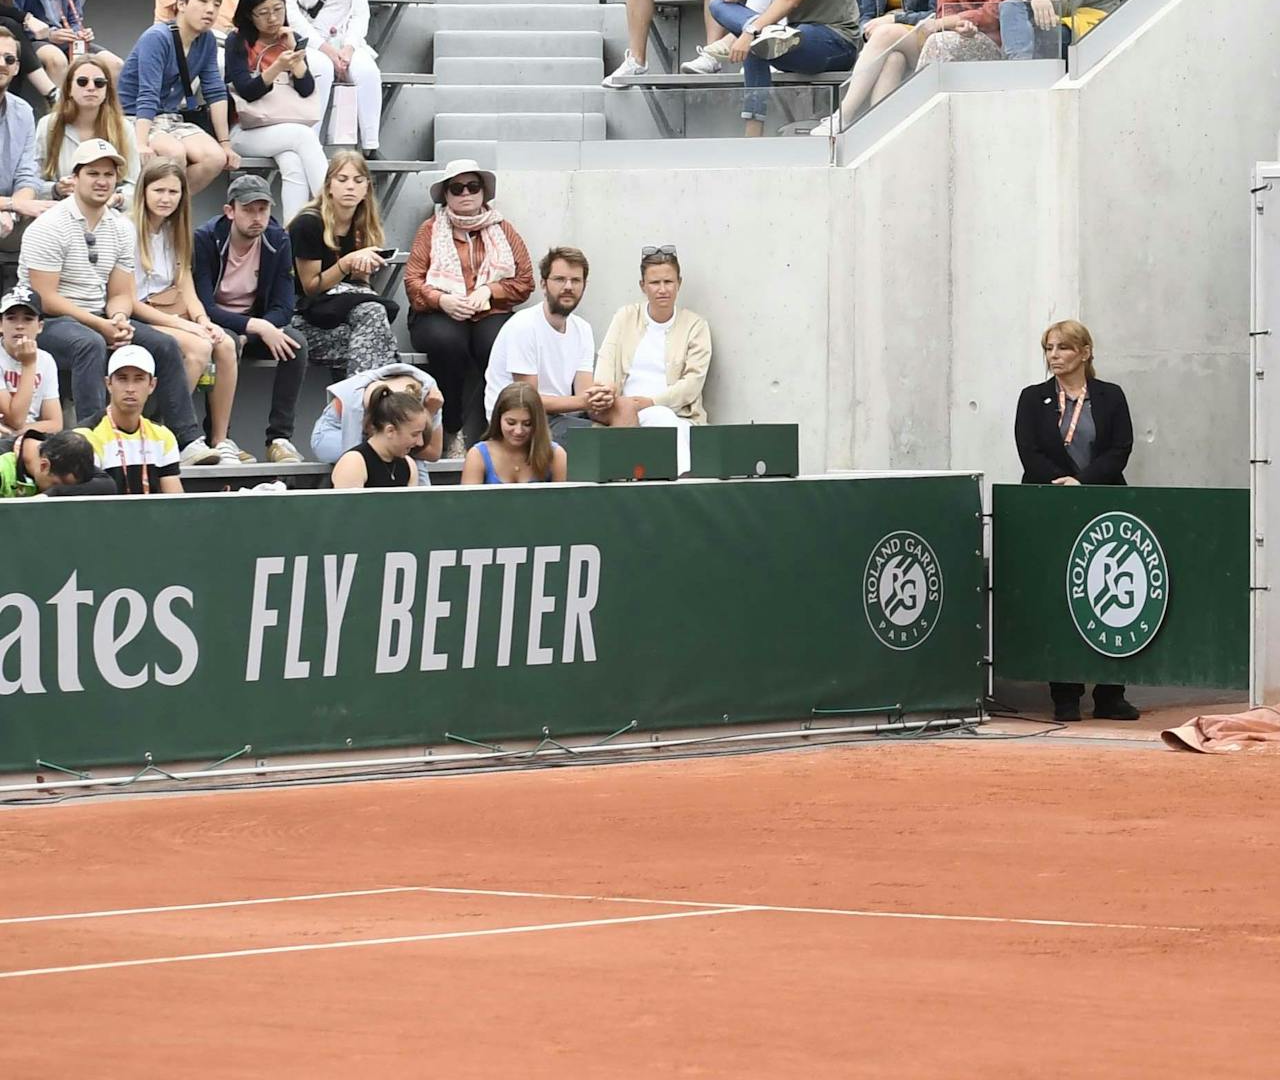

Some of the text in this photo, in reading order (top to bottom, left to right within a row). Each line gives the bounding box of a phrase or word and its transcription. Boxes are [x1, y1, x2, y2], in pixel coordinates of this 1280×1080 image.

[867, 538, 939, 604] ROLAND GARROS
[1072, 521, 1163, 600] ROLAND GARROS
[246, 553, 359, 682] FLY
[376, 544, 601, 674] BETTER
[879, 619, 928, 642] PARIS
[1087, 619, 1149, 647] PARIS
